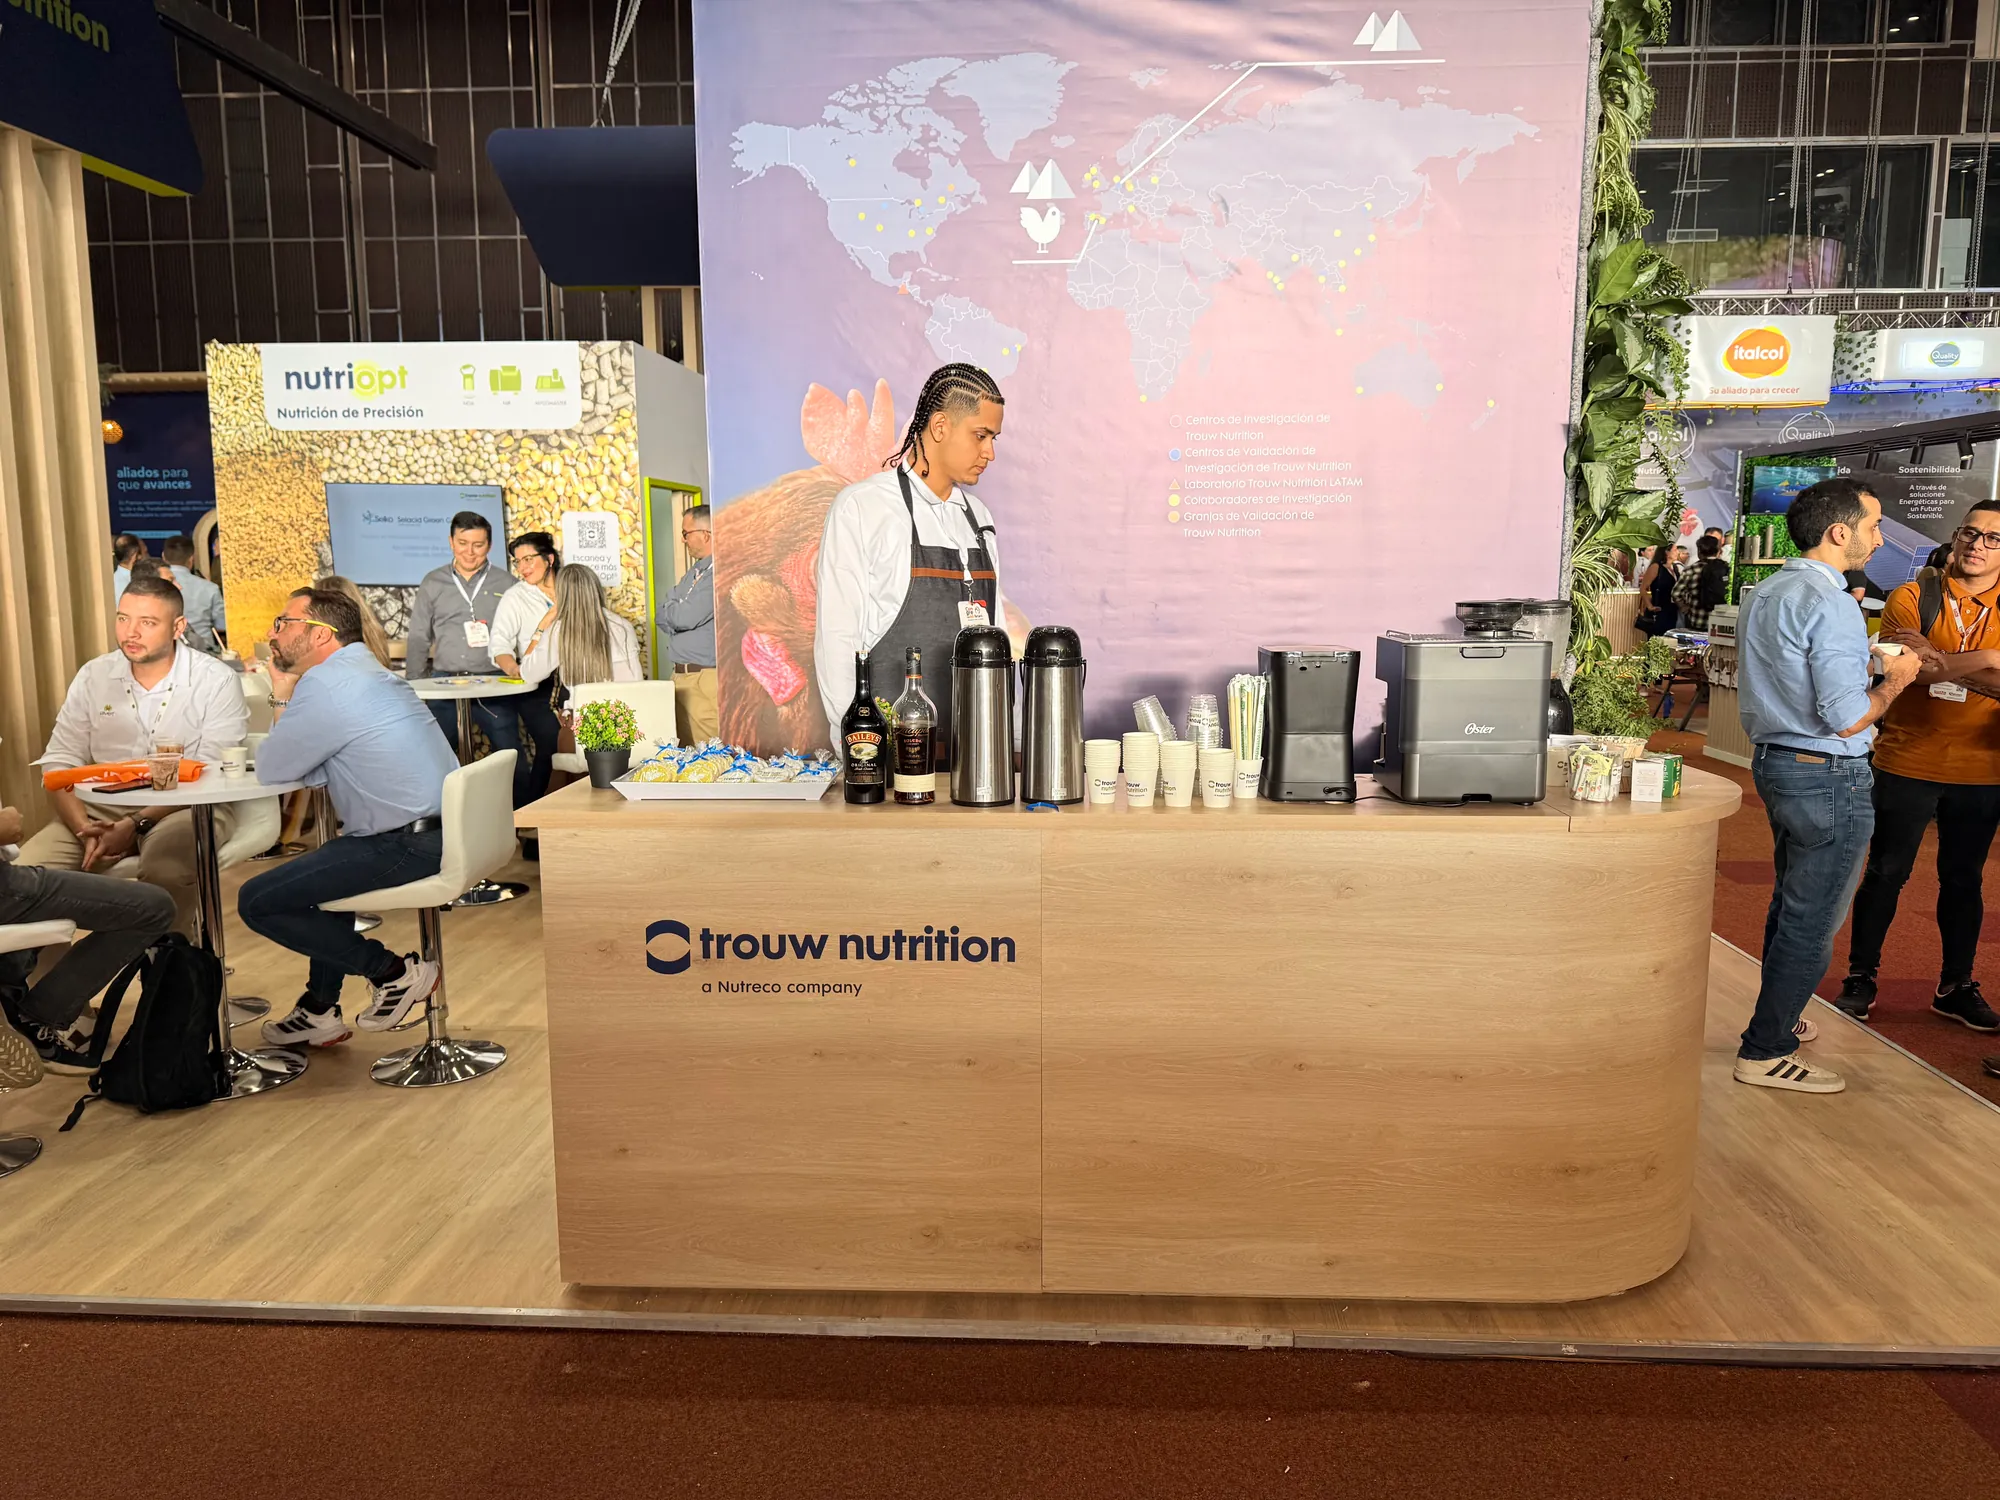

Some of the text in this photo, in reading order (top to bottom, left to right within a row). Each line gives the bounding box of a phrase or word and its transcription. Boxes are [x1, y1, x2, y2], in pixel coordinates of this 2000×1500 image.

[7, 0, 110, 53] rition
[1734, 345, 1785, 360] italcol
[1932, 350, 1959, 360] Quality
[285, 362, 408, 395] nutriopt
[1709, 386, 1719, 394] Su
[1721, 386, 1748, 394] aliado
[1750, 387, 1770, 395] para
[277, 405, 424, 419] Nutrición de Precisión
[1185, 413, 1331, 425] Centros de Investigación de
[1185, 430, 1264, 441] Trouw Nutrition
[1185, 445, 1316, 457] Centros de Validación de
[116, 466, 189, 480] aliados para
[1184, 460, 1352, 474] Investigación de Trouw Nutrition
[117, 480, 192, 492] que avances
[1184, 477, 1363, 489] Laboratorio Trouw Nutrition LATAM
[1184, 492, 1352, 505] Colaboradores de Investigación
[1899, 498, 1938, 506] Energéticas
[1183, 510, 1315, 523] Granjas de Validación de
[1183, 527, 1261, 538] Trouw Nutrition
[572, 554, 612, 563] Escanea y
[1464, 722, 1496, 735] Oster
[847, 731, 880, 743] BAILEYS
[700, 925, 1015, 963] trouw nutrition
[701, 980, 863, 997] a Nutreco company
